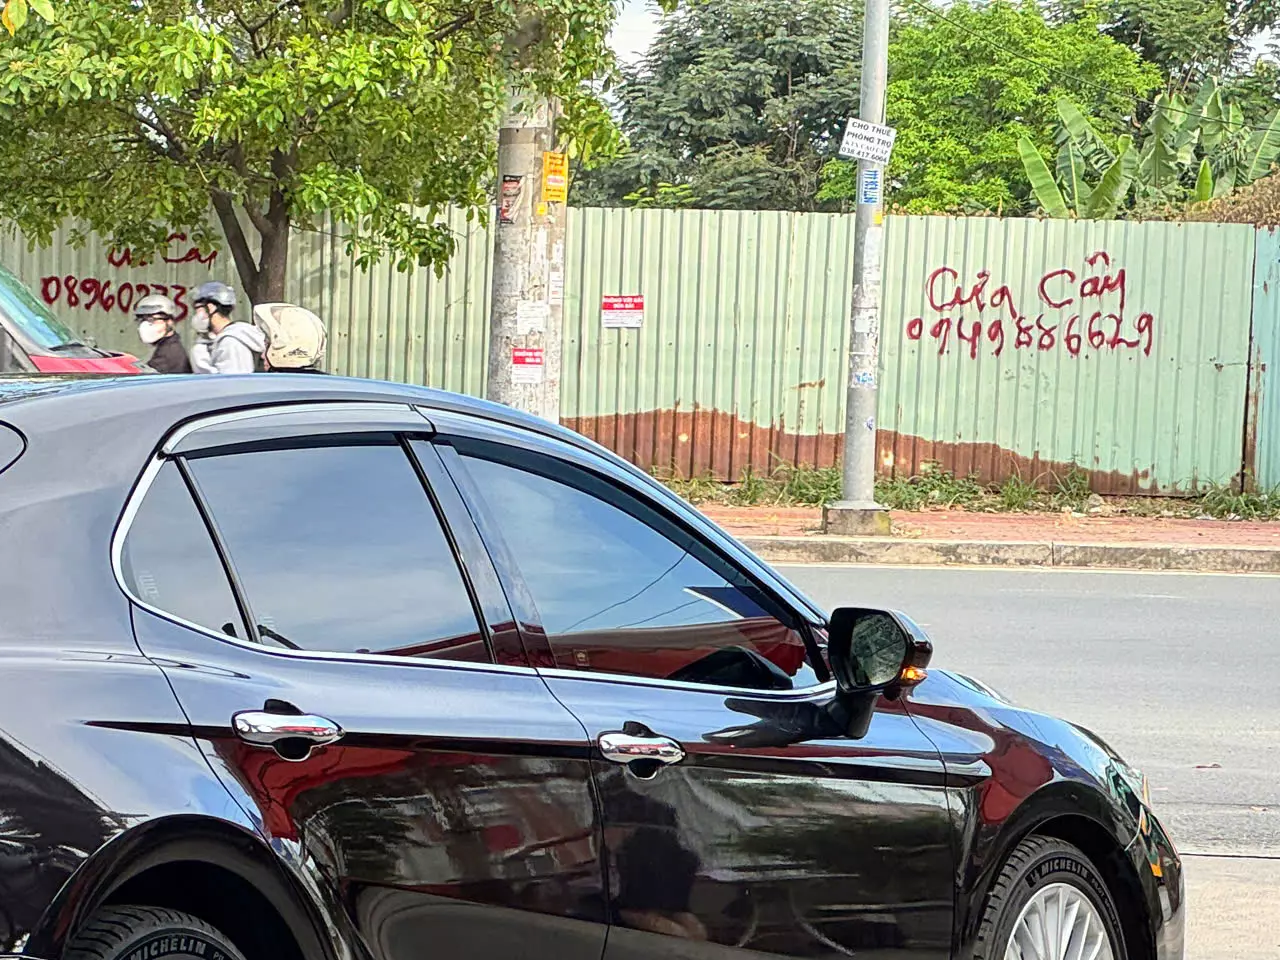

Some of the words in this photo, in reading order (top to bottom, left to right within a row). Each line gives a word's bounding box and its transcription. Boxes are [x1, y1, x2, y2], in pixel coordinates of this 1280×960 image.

[852, 121, 869, 131] CHO
[846, 131, 875, 144] PHÒNG
[1040, 858, 1089, 878] MICHELIN
